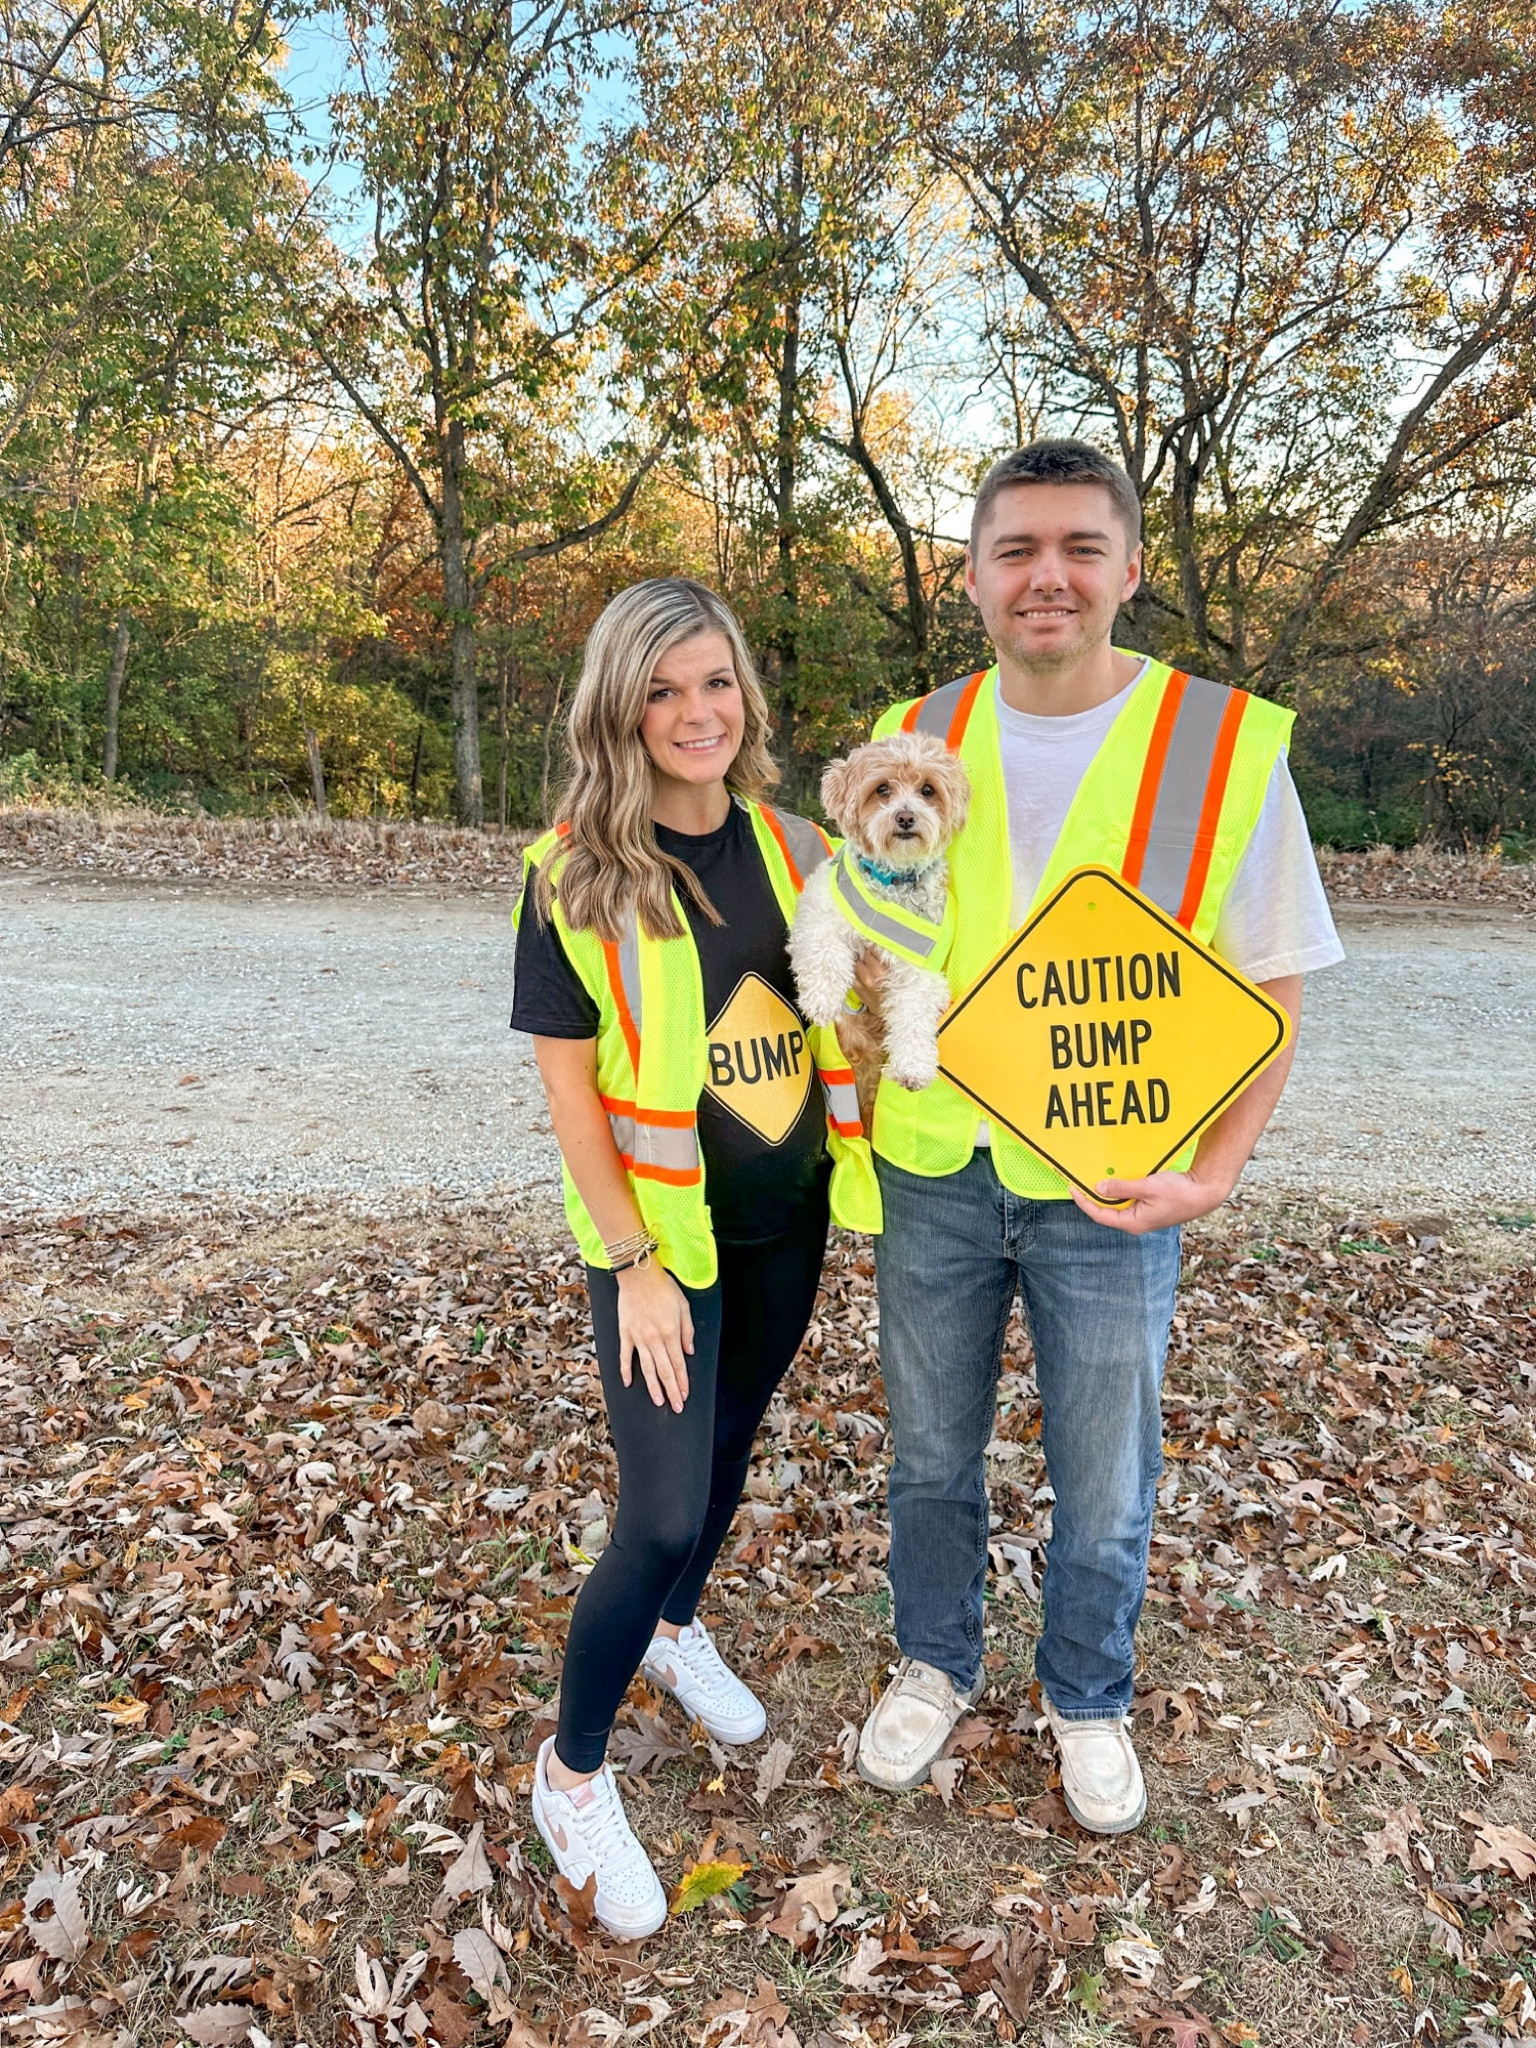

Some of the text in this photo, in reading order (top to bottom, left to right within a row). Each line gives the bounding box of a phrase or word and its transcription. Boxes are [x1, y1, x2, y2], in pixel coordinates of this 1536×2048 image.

[1016, 951, 1181, 1009] CAUTION
[709, 1029, 804, 1086] BUMP
[1050, 1020, 1152, 1069] BUMP
[1045, 1078, 1170, 1129] AHEAD
